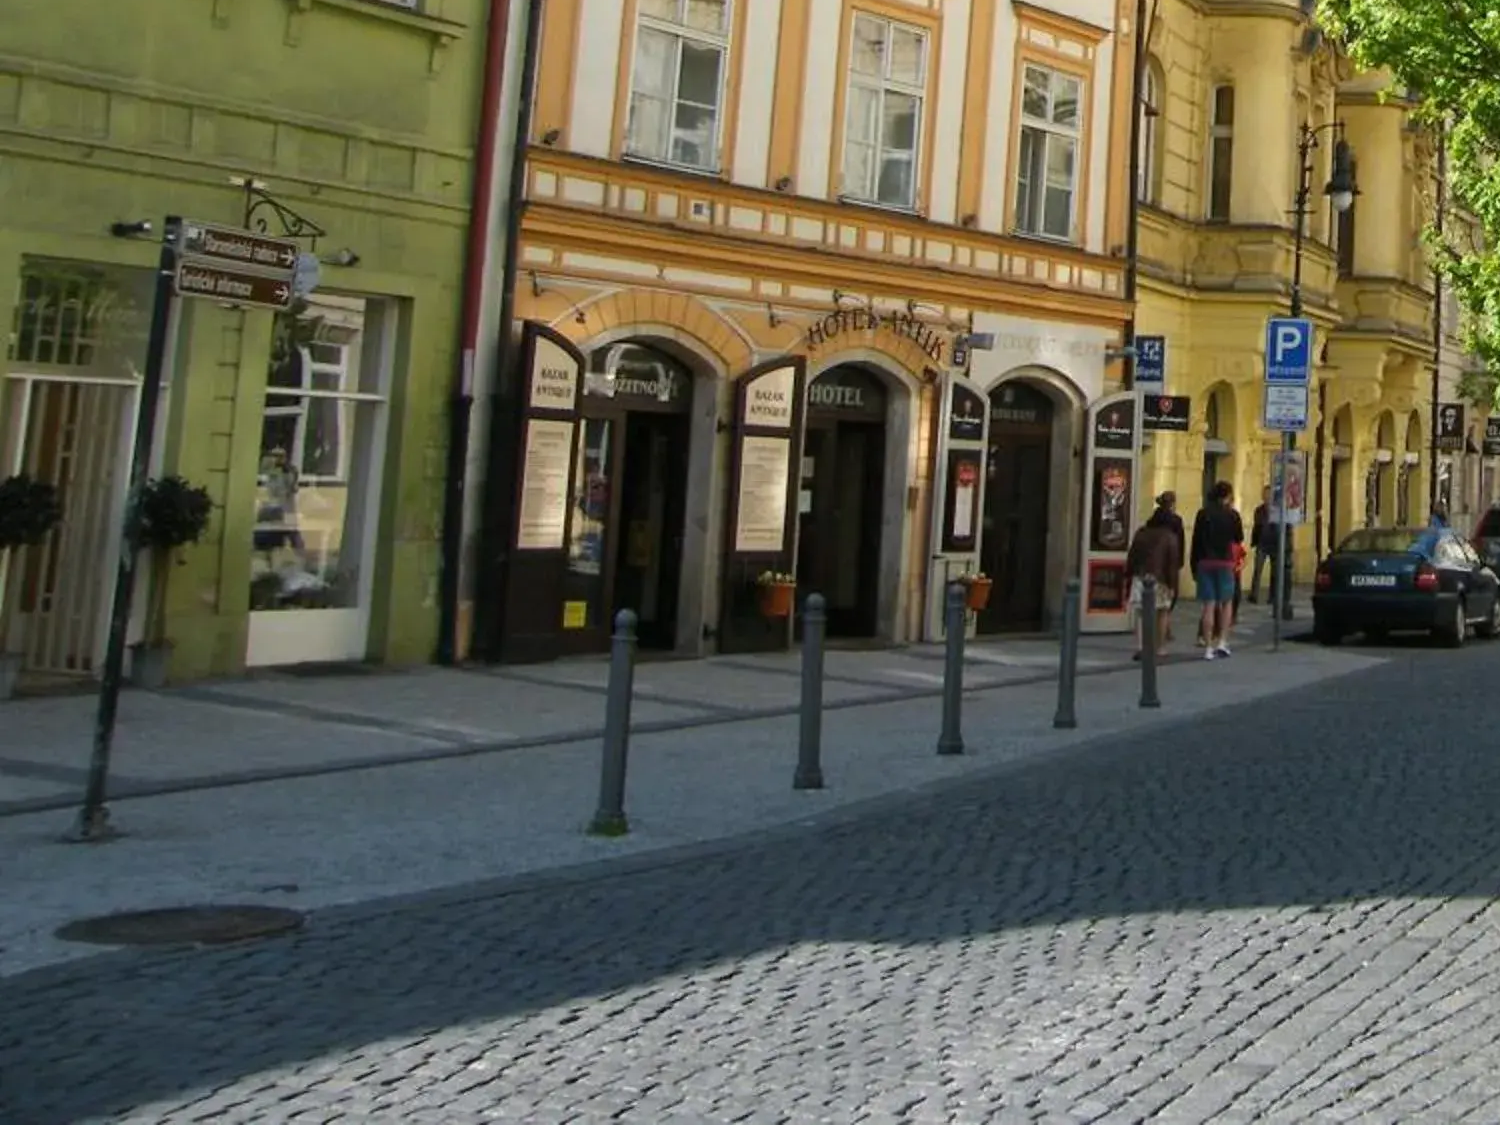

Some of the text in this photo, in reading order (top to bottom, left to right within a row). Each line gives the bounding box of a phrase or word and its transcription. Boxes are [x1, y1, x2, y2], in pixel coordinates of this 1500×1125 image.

[807, 306, 879, 345] HOTEL
[1275, 326, 1301, 363] P
[809, 384, 863, 407] HOTEL
